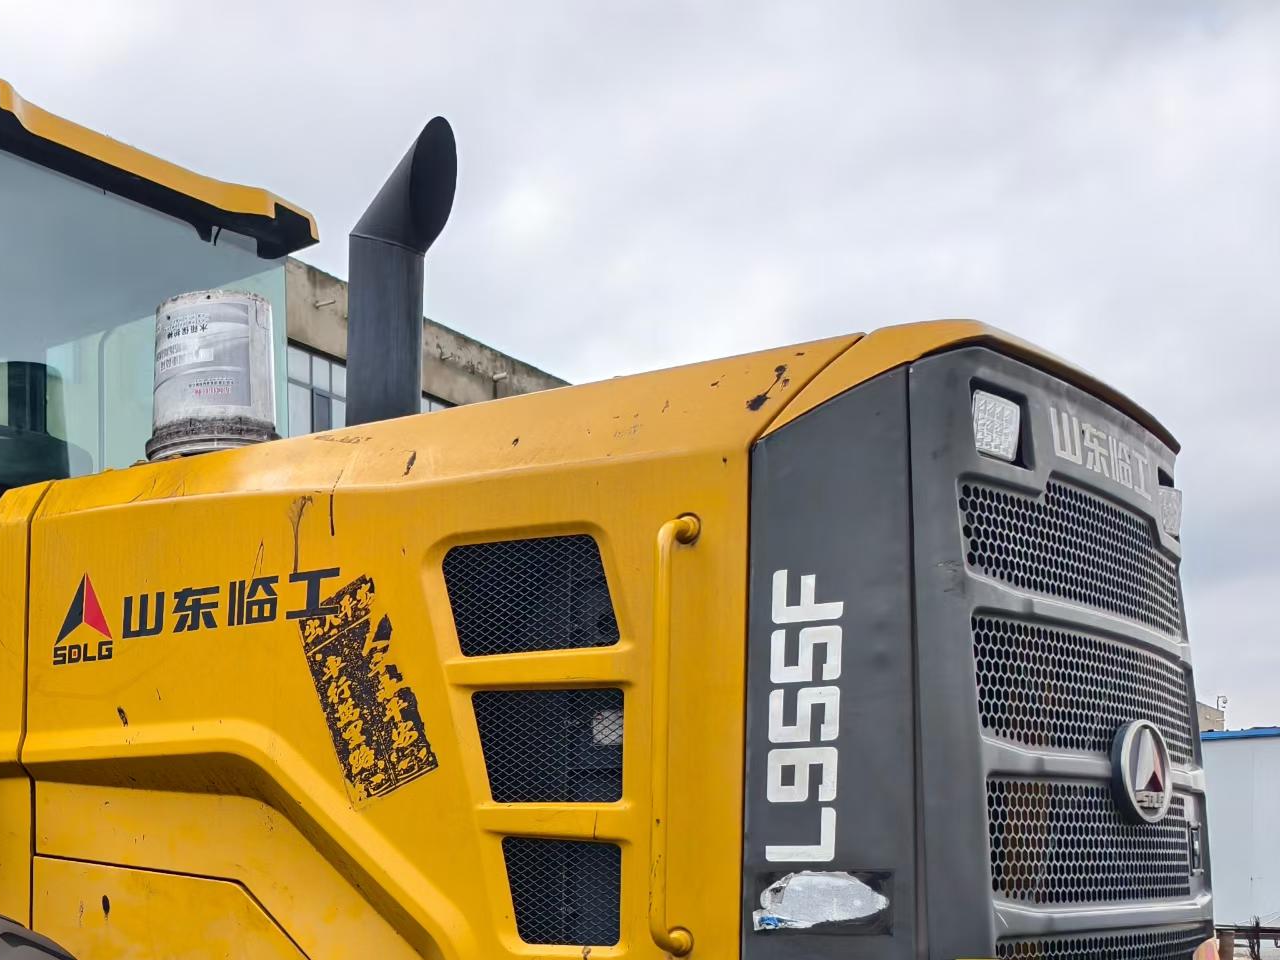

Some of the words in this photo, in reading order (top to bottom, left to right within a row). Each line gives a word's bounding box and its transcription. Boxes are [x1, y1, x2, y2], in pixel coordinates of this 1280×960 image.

[1049, 407, 1153, 501] 山东临工
[122, 567, 341, 639] 山东临工
[53, 641, 113, 665] SDLG
[765, 569, 844, 862] L955F
